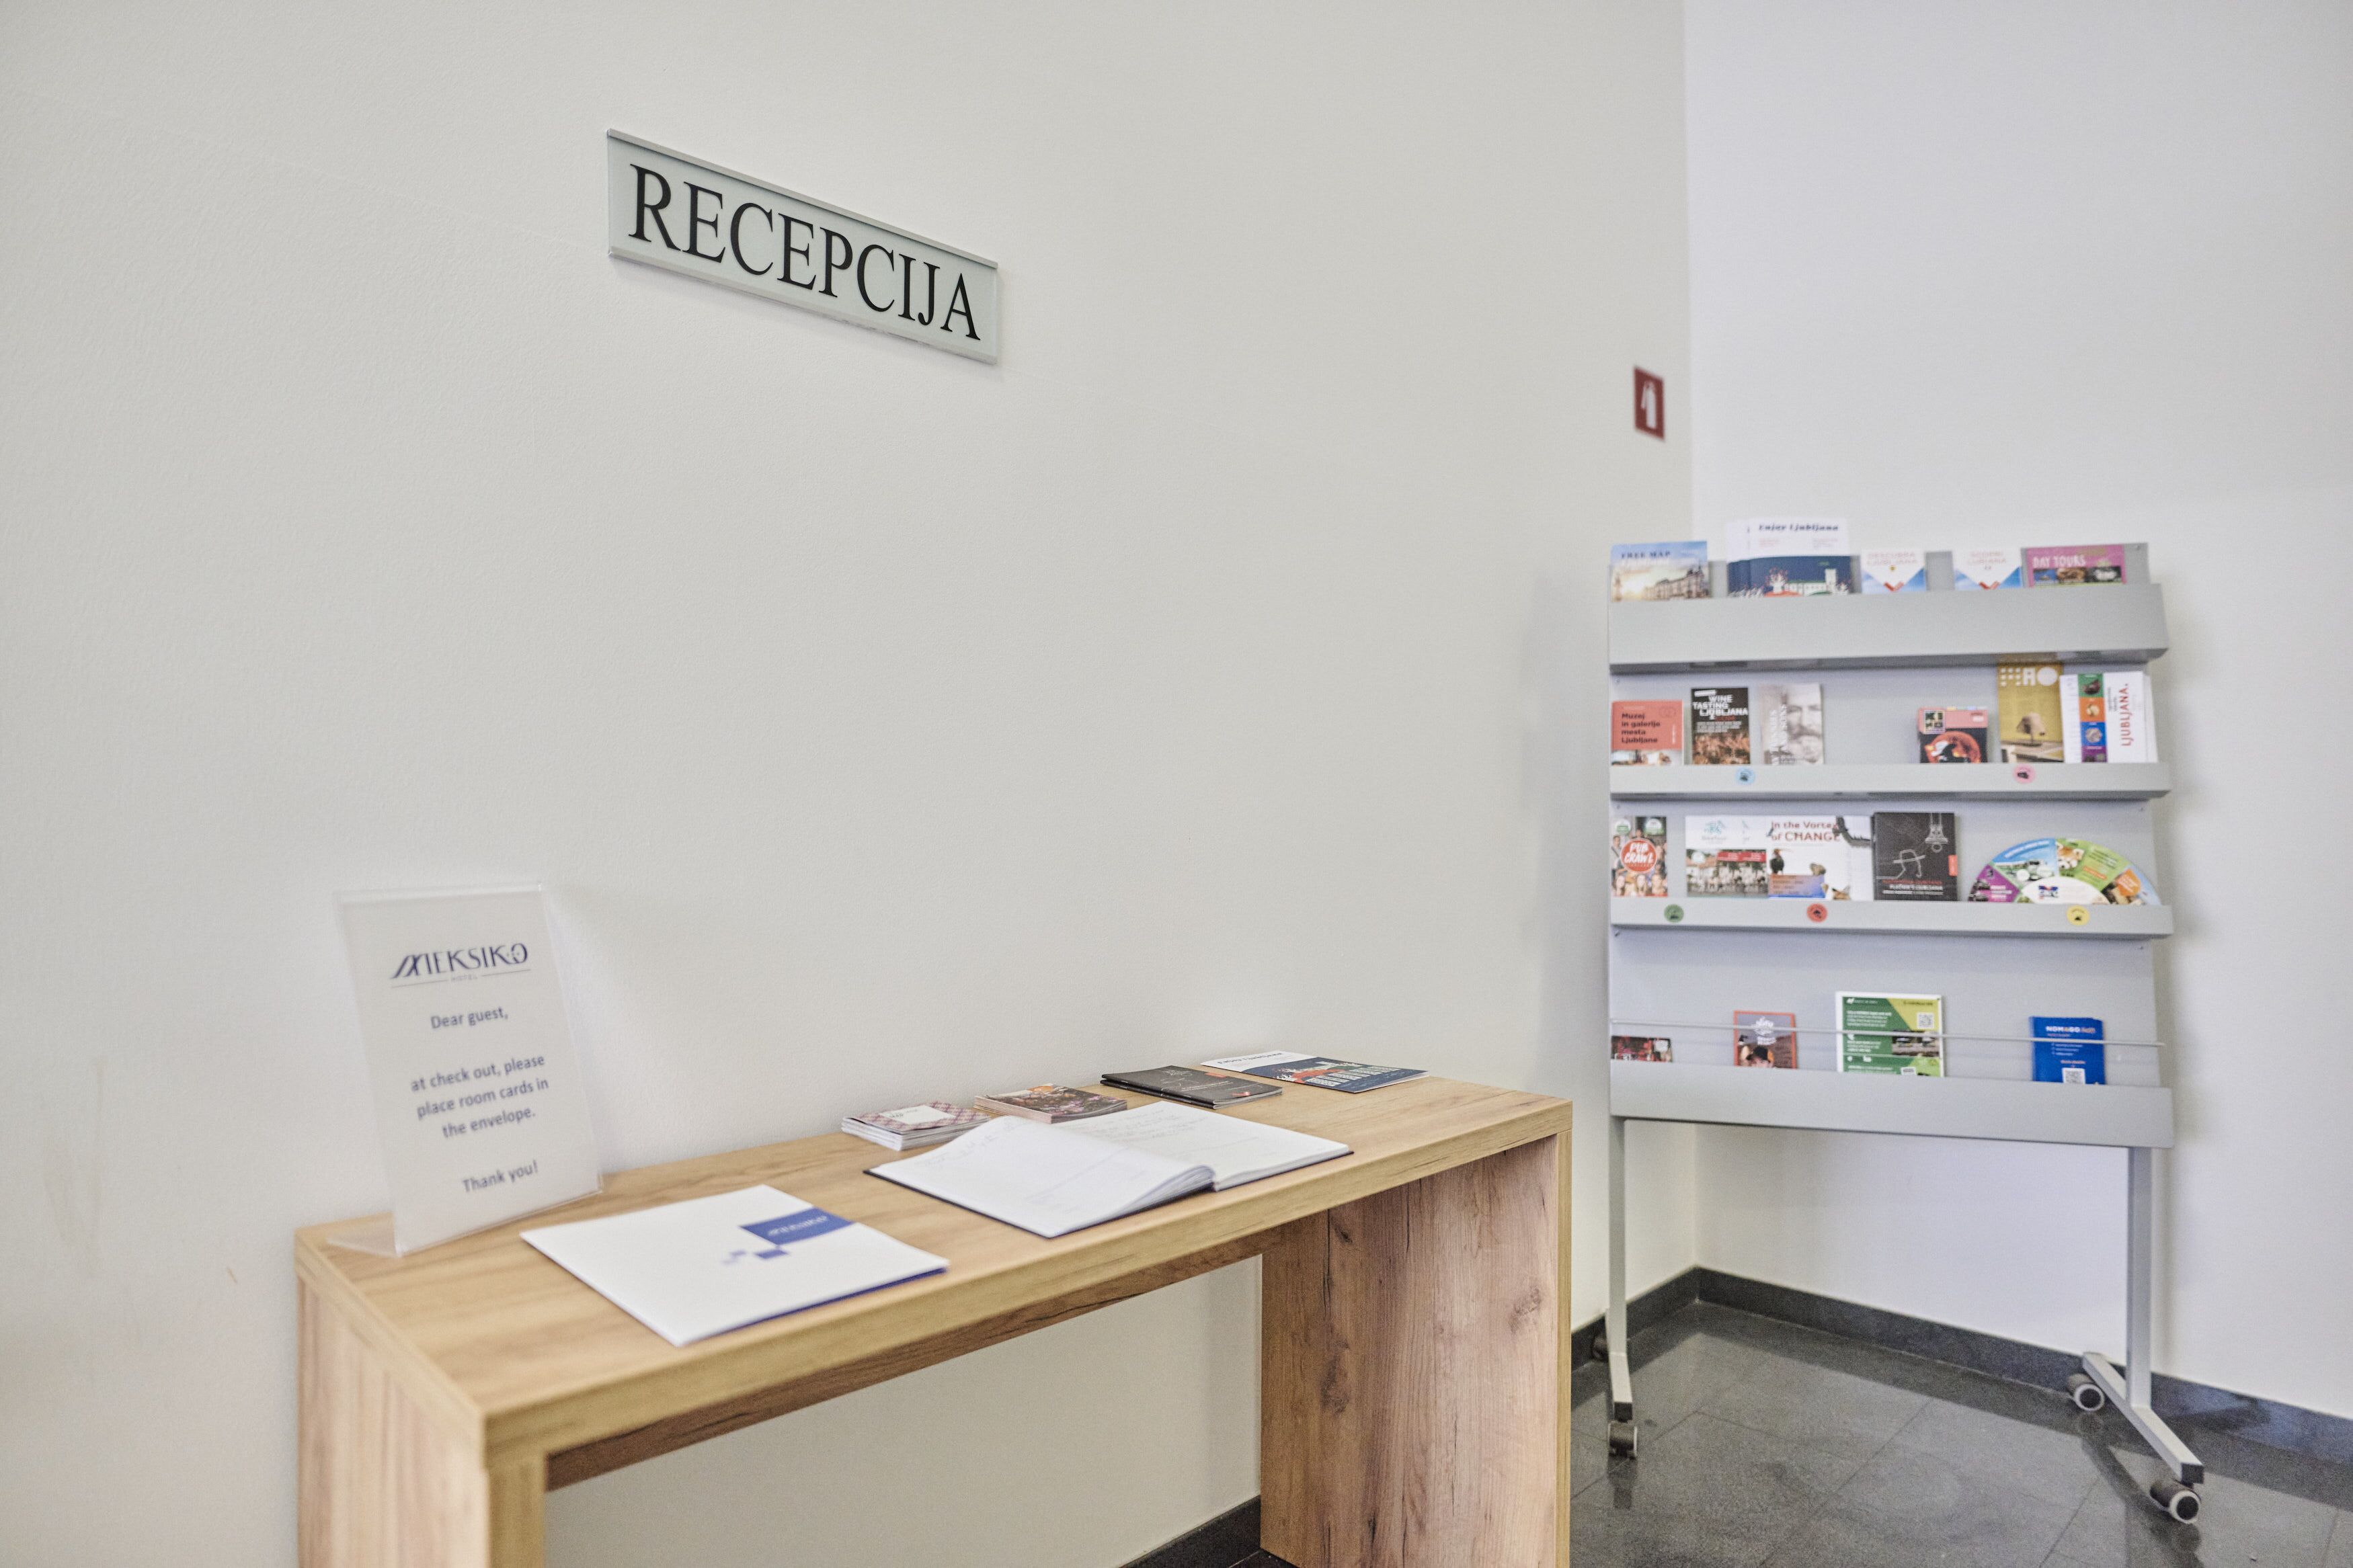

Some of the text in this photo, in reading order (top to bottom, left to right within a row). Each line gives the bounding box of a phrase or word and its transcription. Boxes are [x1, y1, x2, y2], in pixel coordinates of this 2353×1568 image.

[628, 163, 981, 341] RECEPCIJA
[2032, 554, 2086, 568] DAY TOURS
[1693, 701, 1728, 710] TASTING
[1709, 695, 1733, 703] WINE
[1784, 821, 1800, 829] the
[1785, 831, 1841, 841] CHANGE
[1630, 842, 1648, 854] PUB
[1624, 852, 1654, 864] CRAWL
[390, 943, 528, 979] MEKSIKO
[430, 1007, 508, 1029] Dear guest,
[411, 1055, 545, 1092] at check out, please
[416, 1077, 549, 1121] place room cards in
[442, 1108, 535, 1138] the envelope.
[463, 1159, 539, 1192] Thank you!
